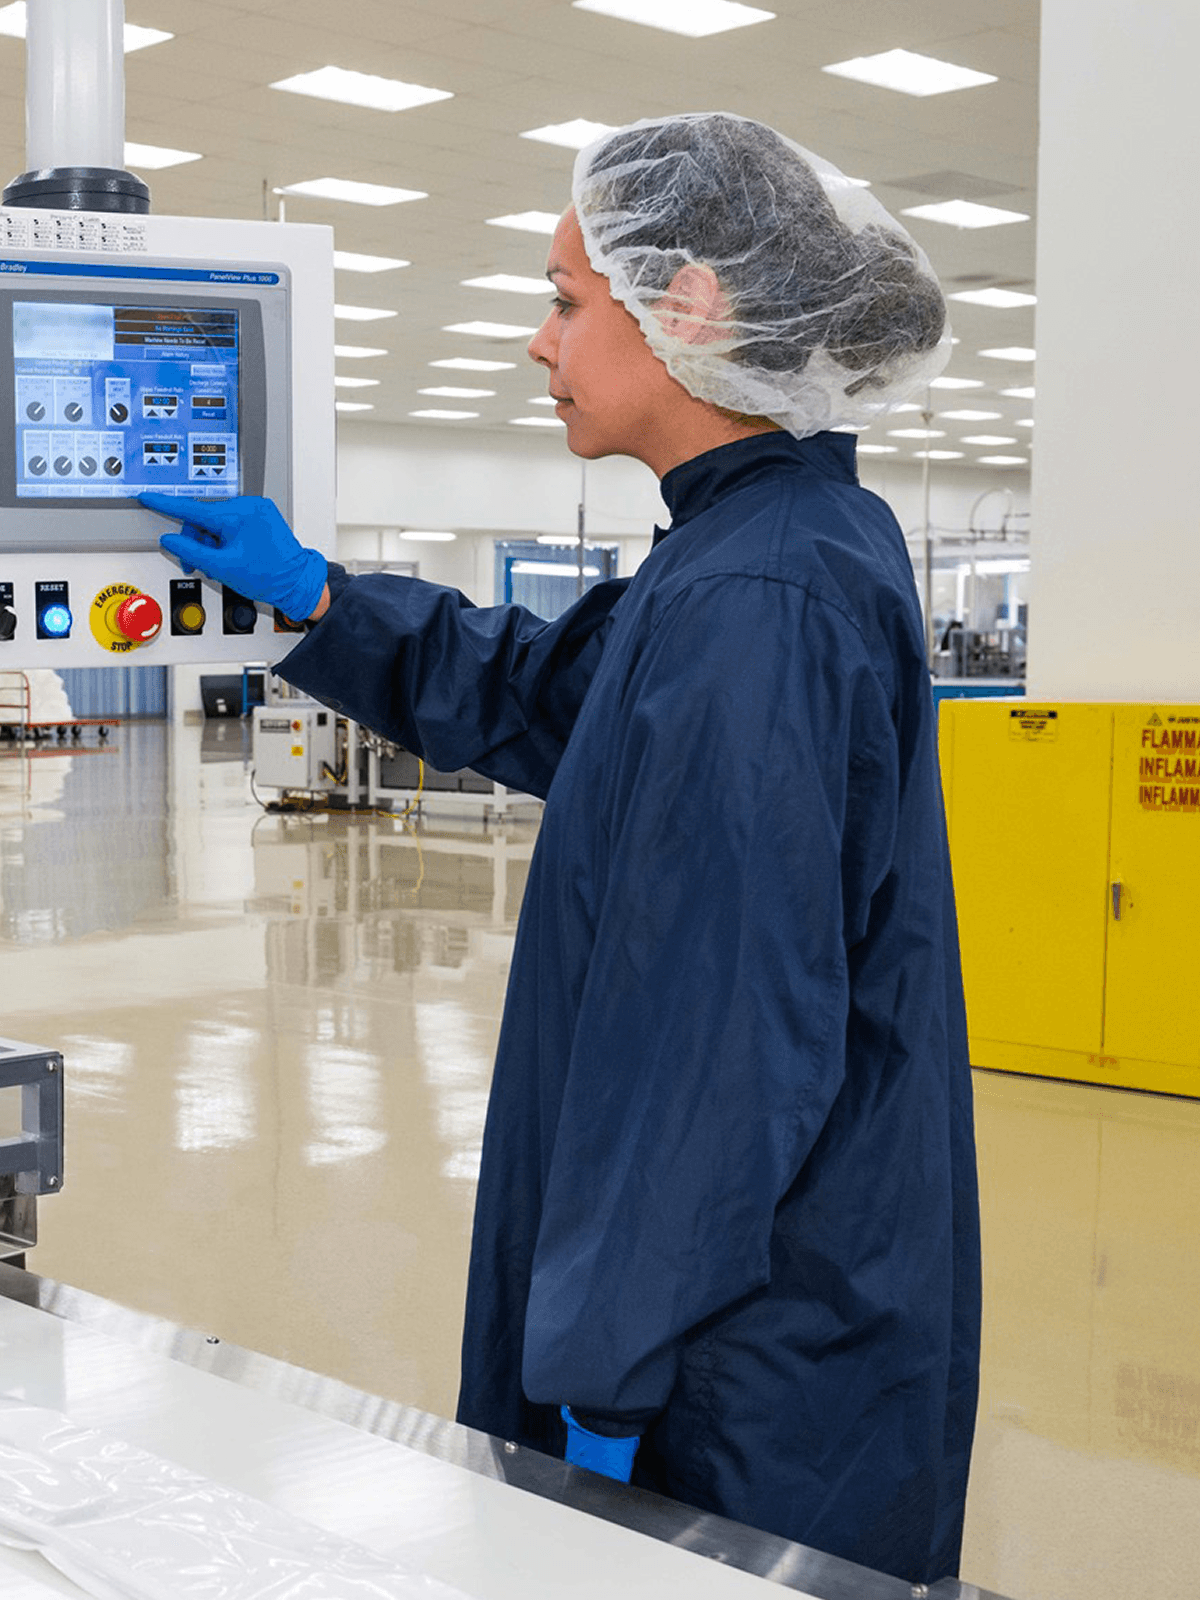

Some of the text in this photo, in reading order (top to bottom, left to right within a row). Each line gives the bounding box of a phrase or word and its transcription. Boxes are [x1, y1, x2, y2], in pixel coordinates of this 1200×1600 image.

[209, 272, 241, 281] PanelView
[242, 274, 257, 282] Plus
[202, 410, 216, 418] Reset
[39, 583, 65, 592] RESET
[177, 581, 196, 589] HOME
[94, 585, 138, 608] EMERGEN
[111, 641, 133, 651] STOP
[1139, 757, 1200, 778] INFLAM
